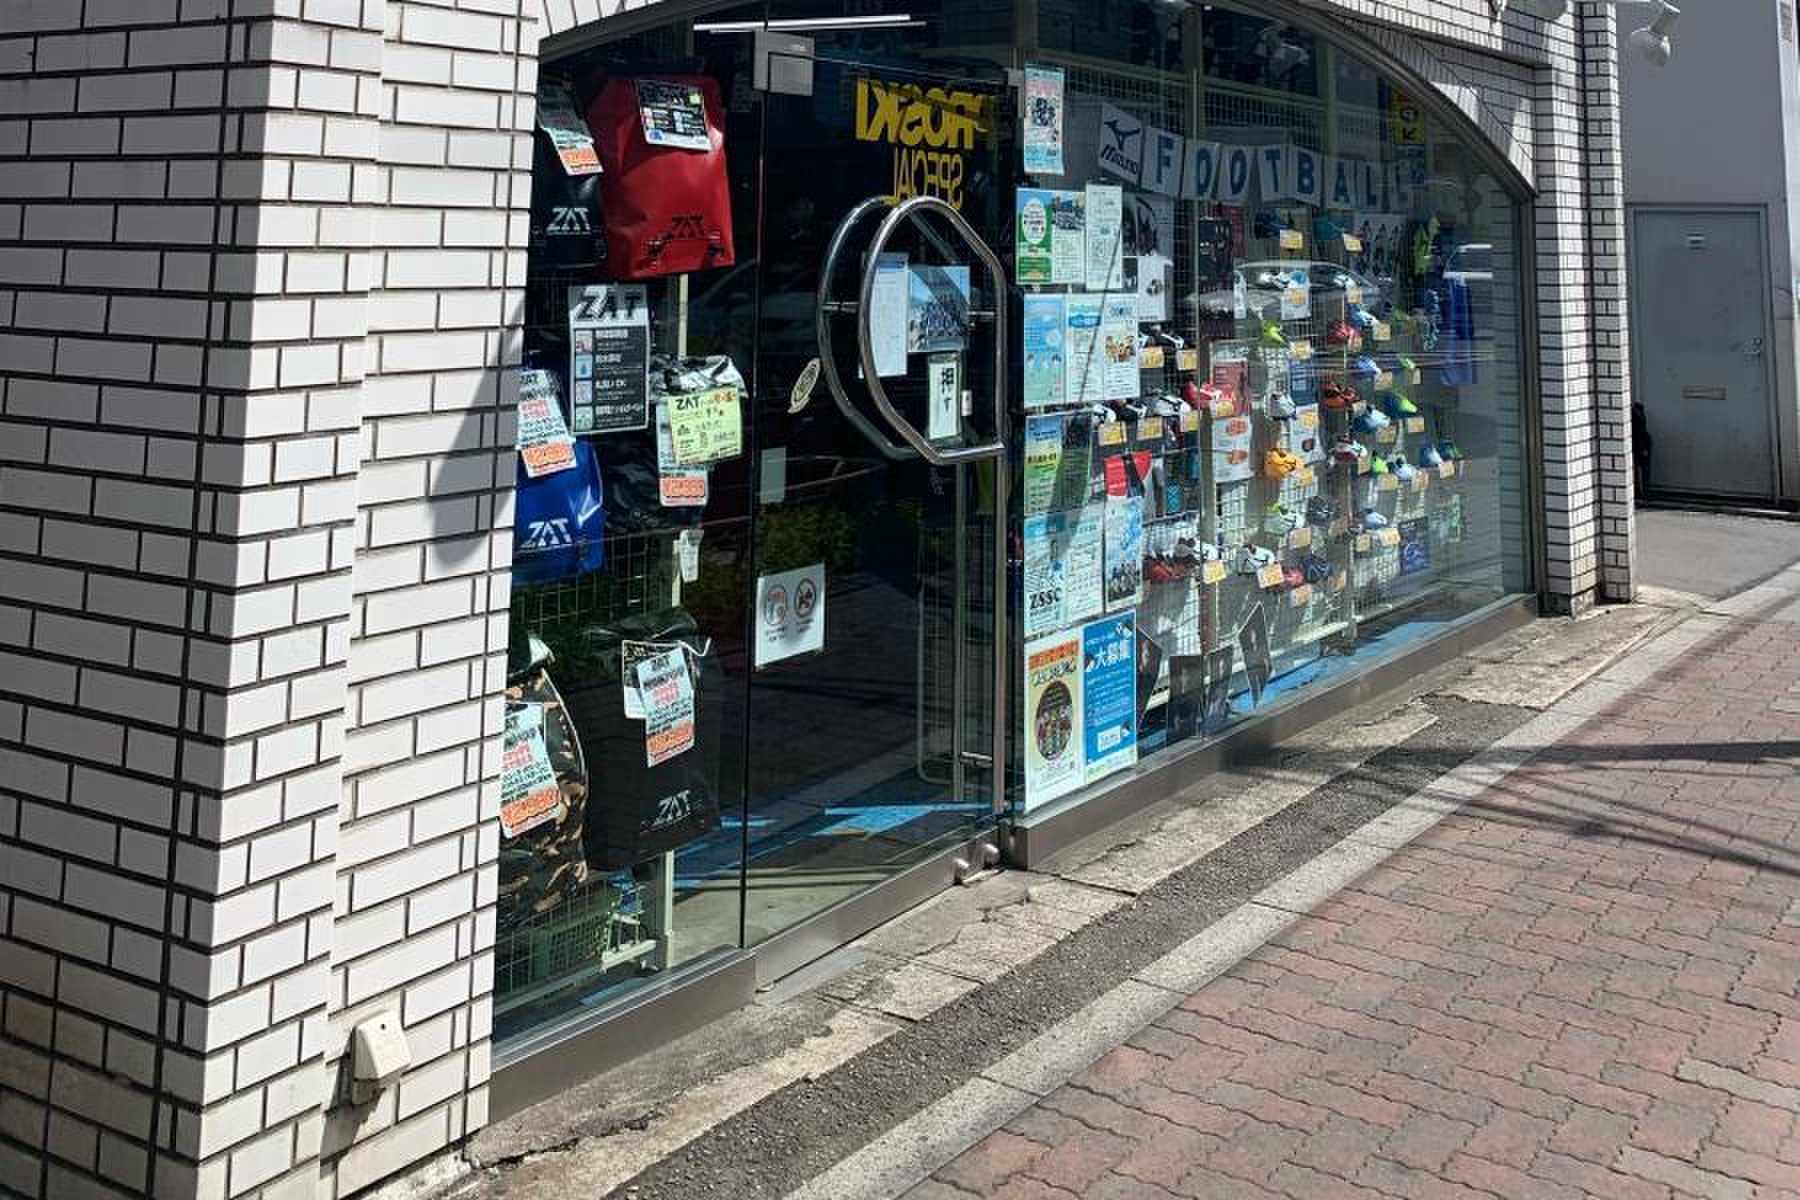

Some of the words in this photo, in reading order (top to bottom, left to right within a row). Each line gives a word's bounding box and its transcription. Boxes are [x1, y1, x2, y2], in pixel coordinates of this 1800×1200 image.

[548, 206, 591, 232] ZAT
[676, 395, 701, 411] ZAT
[525, 518, 574, 548] ZAT
[655, 789, 691, 822] ZAT
